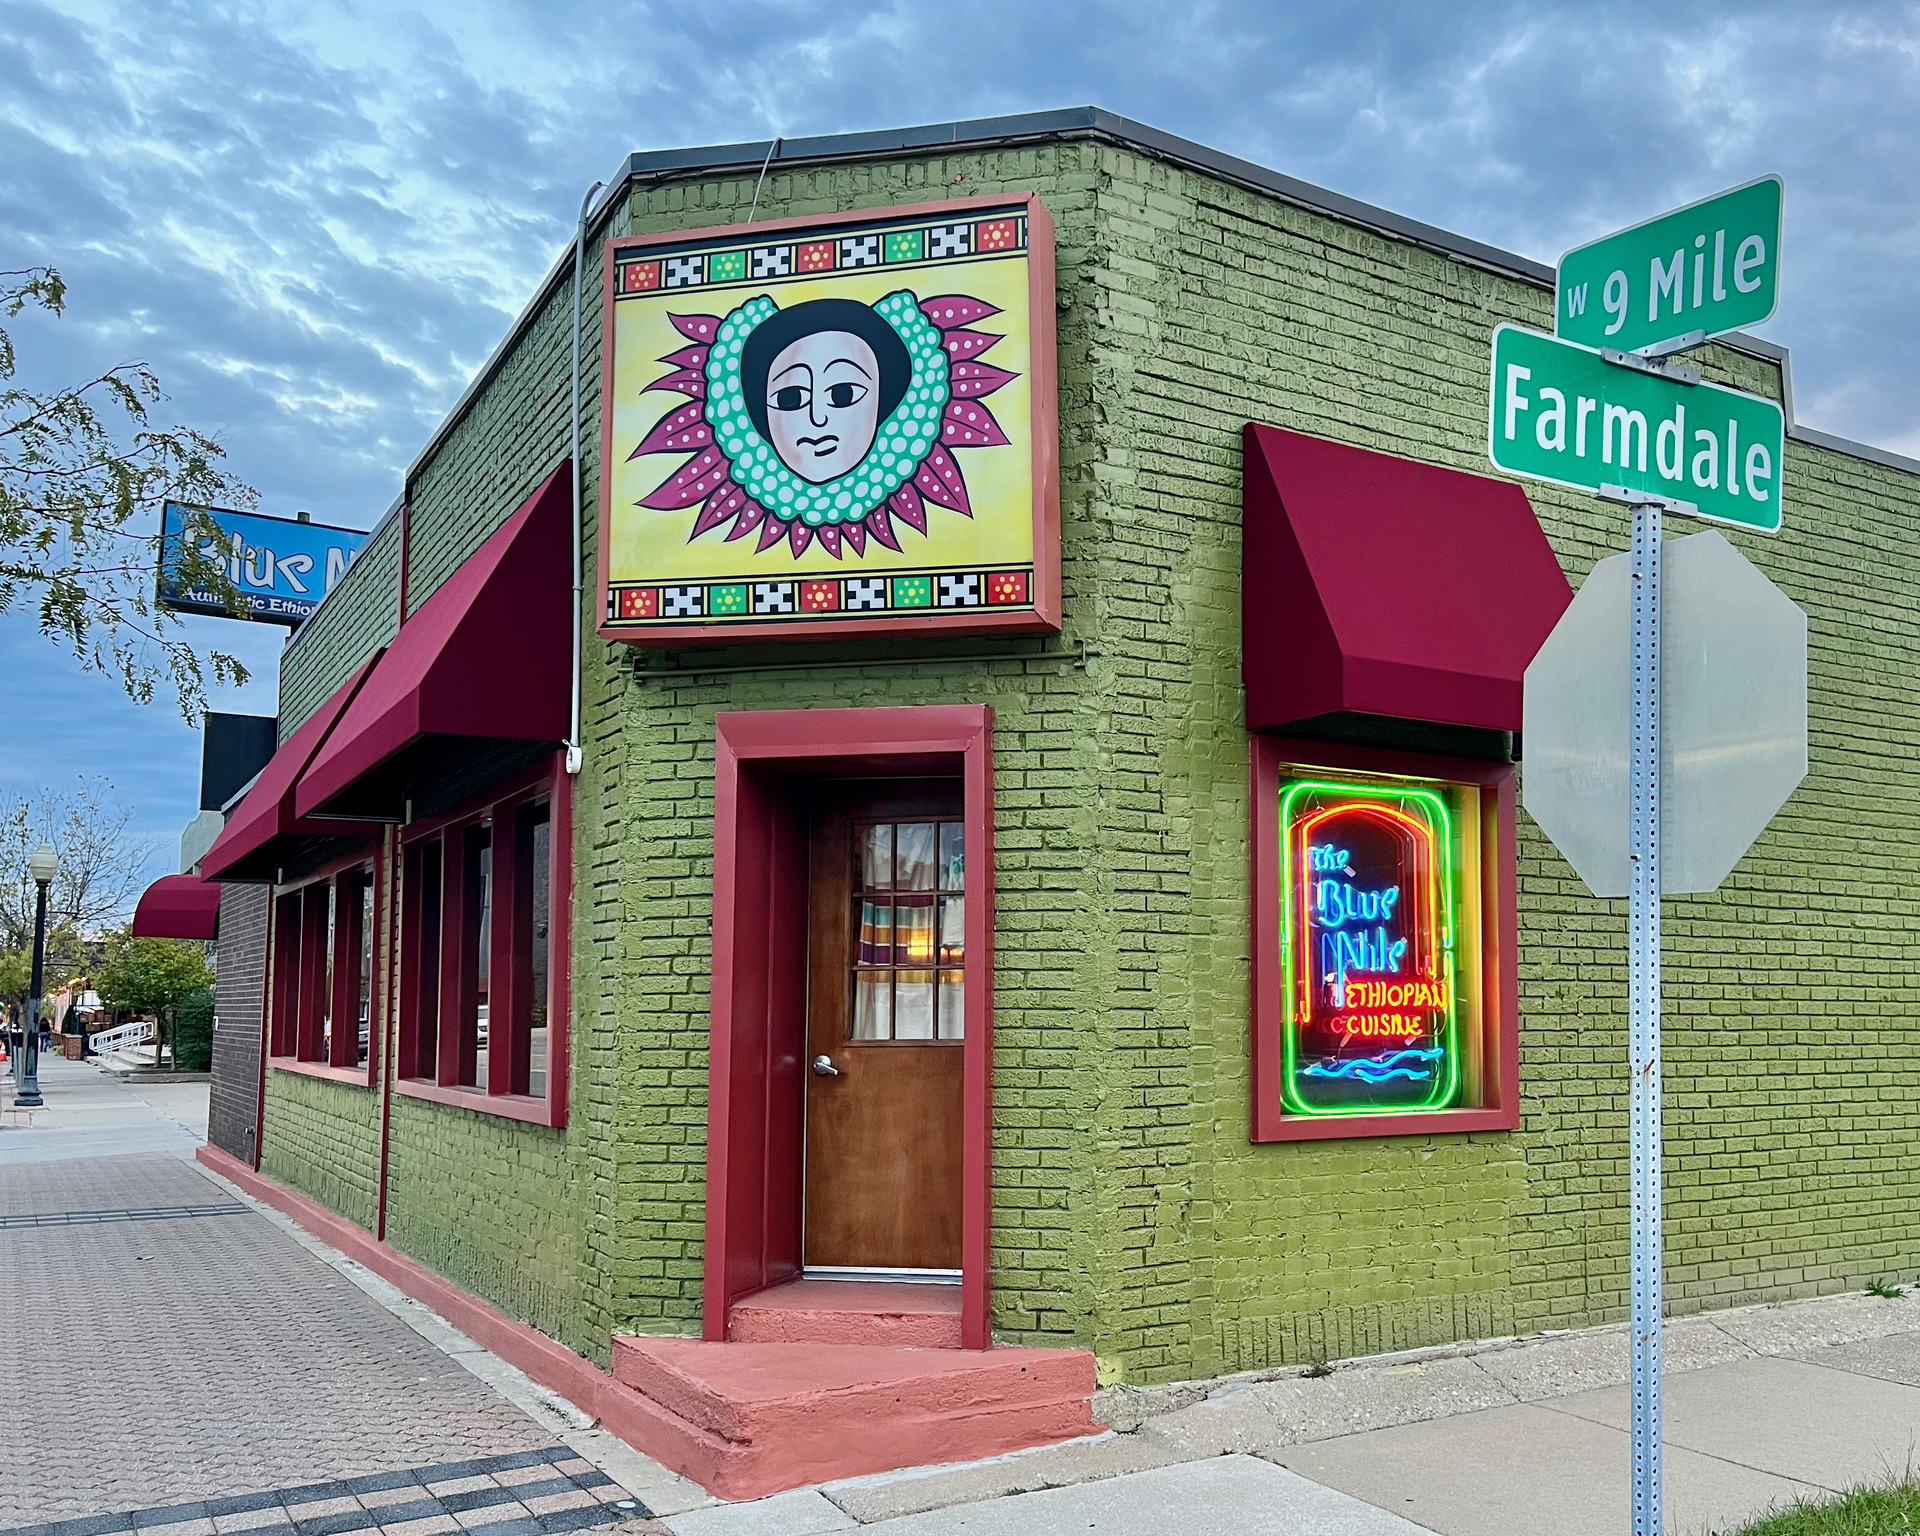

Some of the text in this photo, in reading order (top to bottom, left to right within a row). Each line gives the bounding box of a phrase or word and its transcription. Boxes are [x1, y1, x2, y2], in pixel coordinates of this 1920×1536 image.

[1567, 228, 1766, 335] W 9 Mile
[1504, 363, 1772, 502] Farmdale
[267, 598, 316, 616] Ethio
[1334, 926, 1406, 1008] Nile
[1345, 980, 1449, 1009] ETHIOPIAN
[1346, 1013, 1424, 1036] CUISINE
